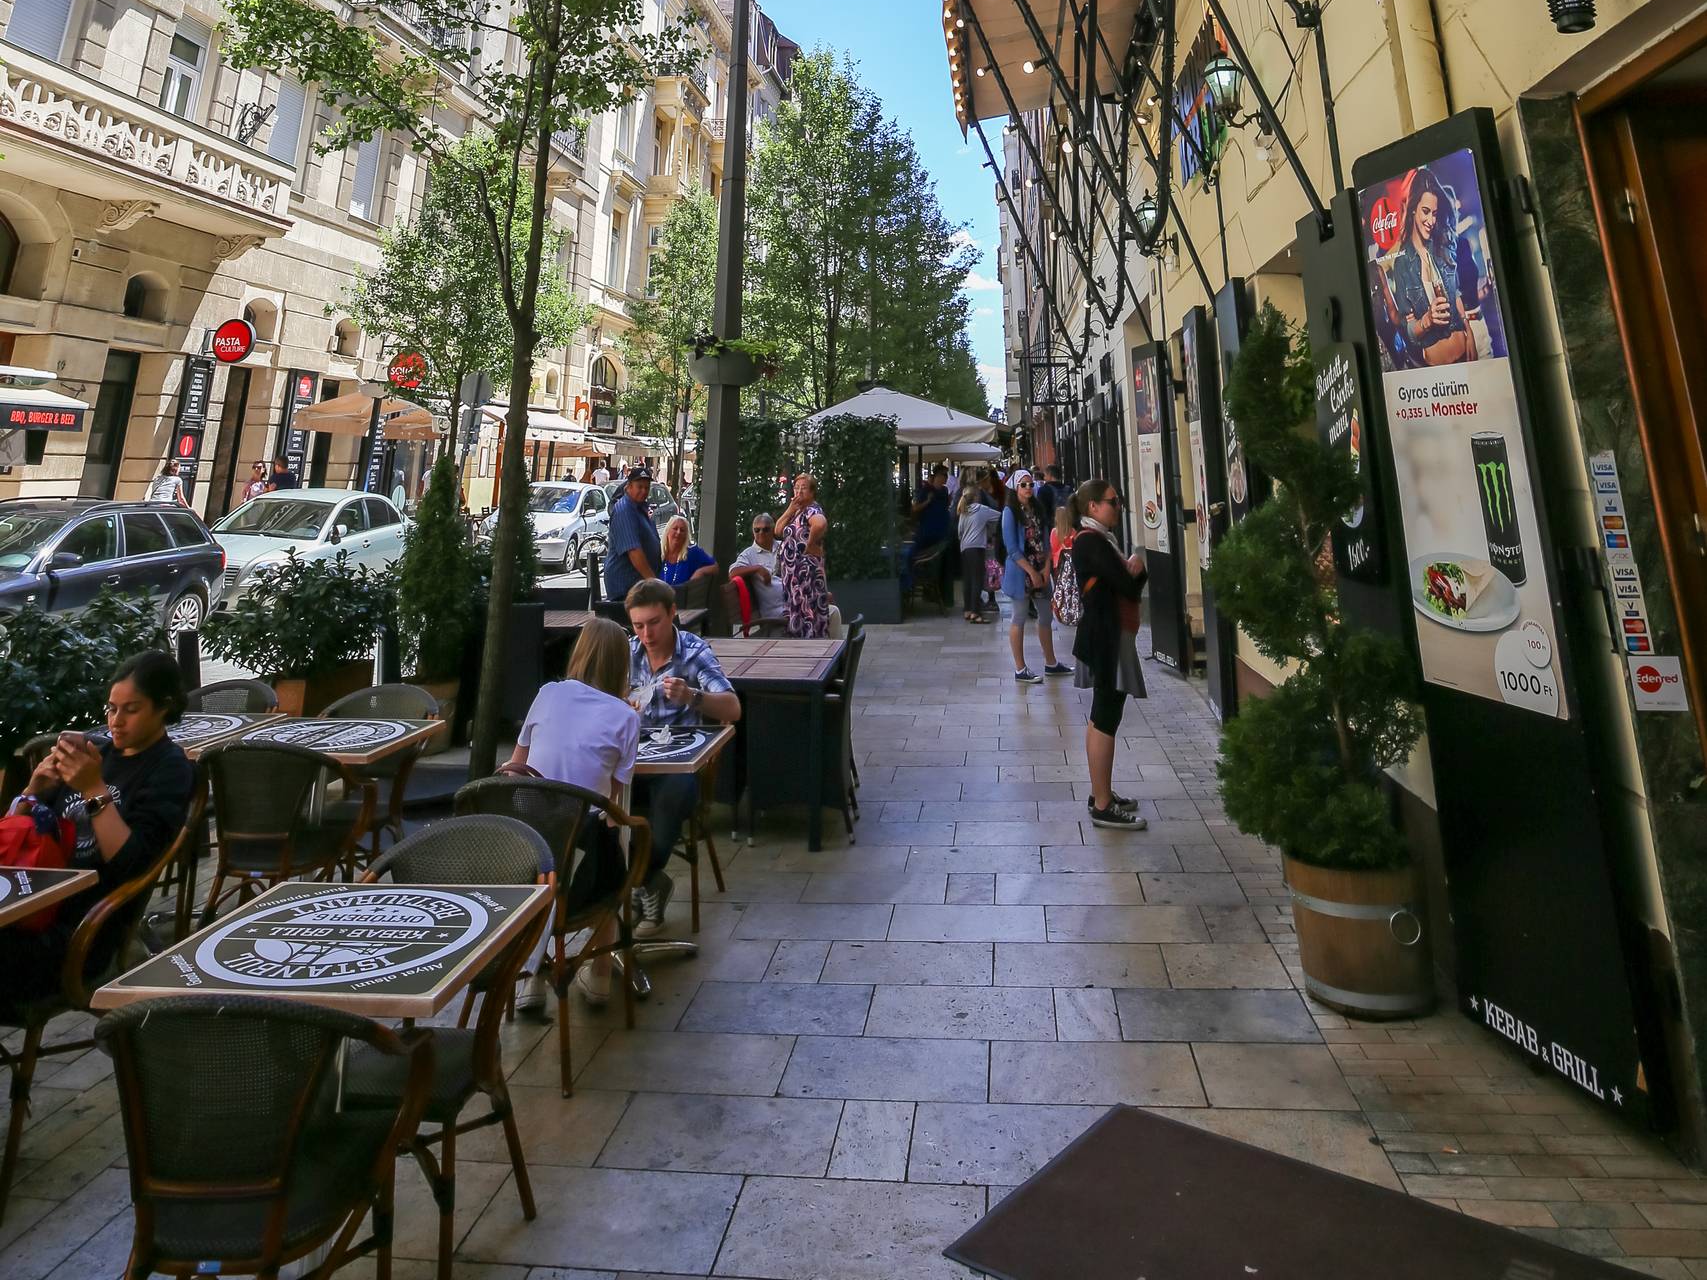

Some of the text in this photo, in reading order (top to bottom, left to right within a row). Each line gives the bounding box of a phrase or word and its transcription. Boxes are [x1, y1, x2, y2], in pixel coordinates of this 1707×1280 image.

[215, 337, 241, 346] PASTA
[220, 345, 246, 353] CULTURE
[1330, 373, 1355, 413] Csirke
[1398, 382, 1470, 403] Gyros dürüm
[1395, 401, 1478, 420] +0,335 L Monster
[10, 410, 76, 425] BBQ, BURGER & BEER
[1328, 407, 1350, 445] menü
[1596, 463, 1613, 471] VISA
[1599, 481, 1617, 489] VISA
[1616, 568, 1635, 576] VISA
[1619, 585, 1639, 594] VISA
[1527, 639, 1542, 650] 100
[1500, 670, 1553, 697] 1000 Ft
[1636, 673, 1679, 684] Edenred
[314, 886, 349, 896] Buon
[290, 894, 465, 920] RESTAURANT
[329, 913, 426, 924] OKTOBER
[268, 926, 334, 937] GRILL
[346, 927, 430, 939] KEBAB
[223, 952, 395, 978] ISTANBUL
[350, 962, 443, 991] Afiyet olsun!
[1484, 998, 1605, 1100] KEBAB & GRILL
